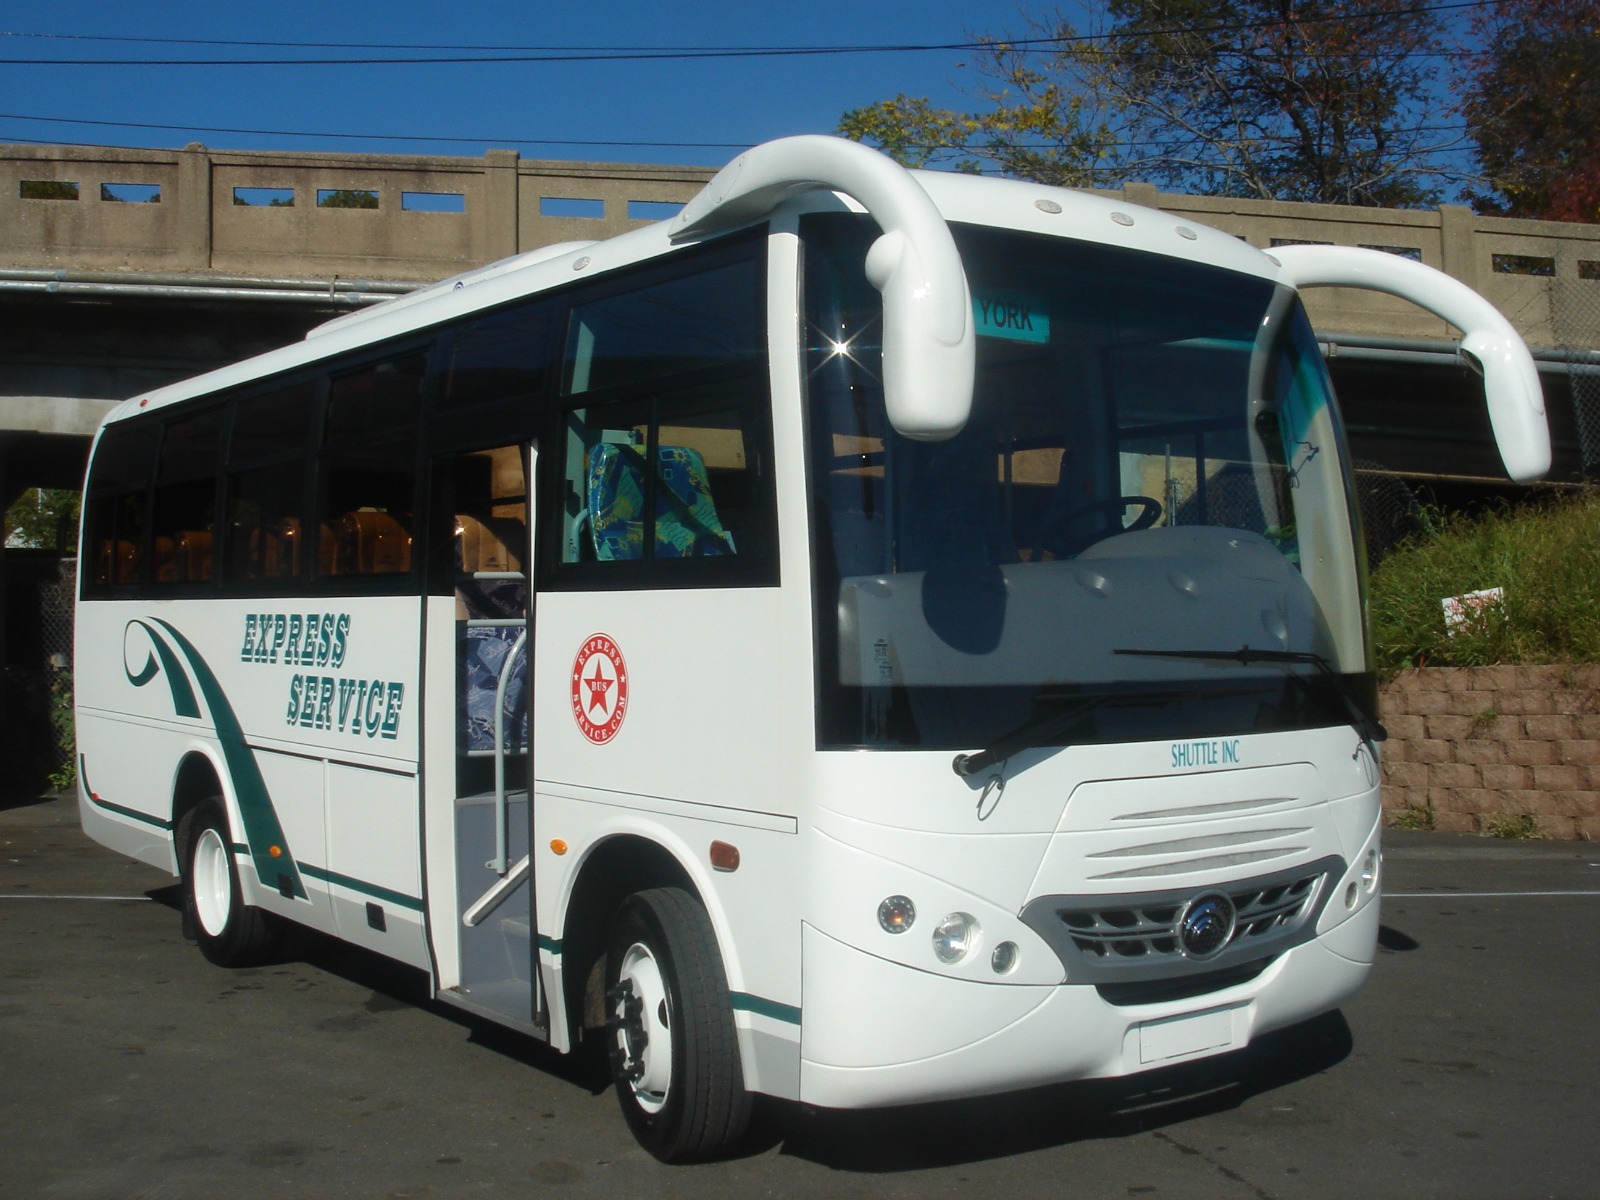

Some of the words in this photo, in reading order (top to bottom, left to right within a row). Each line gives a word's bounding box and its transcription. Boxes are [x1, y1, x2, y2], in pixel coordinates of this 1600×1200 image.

[981, 300, 1033, 331] YORK
[241, 613, 351, 669] EXPRESS
[578, 639, 621, 666] EXPRESS
[591, 681, 608, 692] BUS
[286, 674, 405, 740] SERVICE
[1171, 742, 1218, 768] SHUTTLE
[1221, 739, 1240, 763] INC
